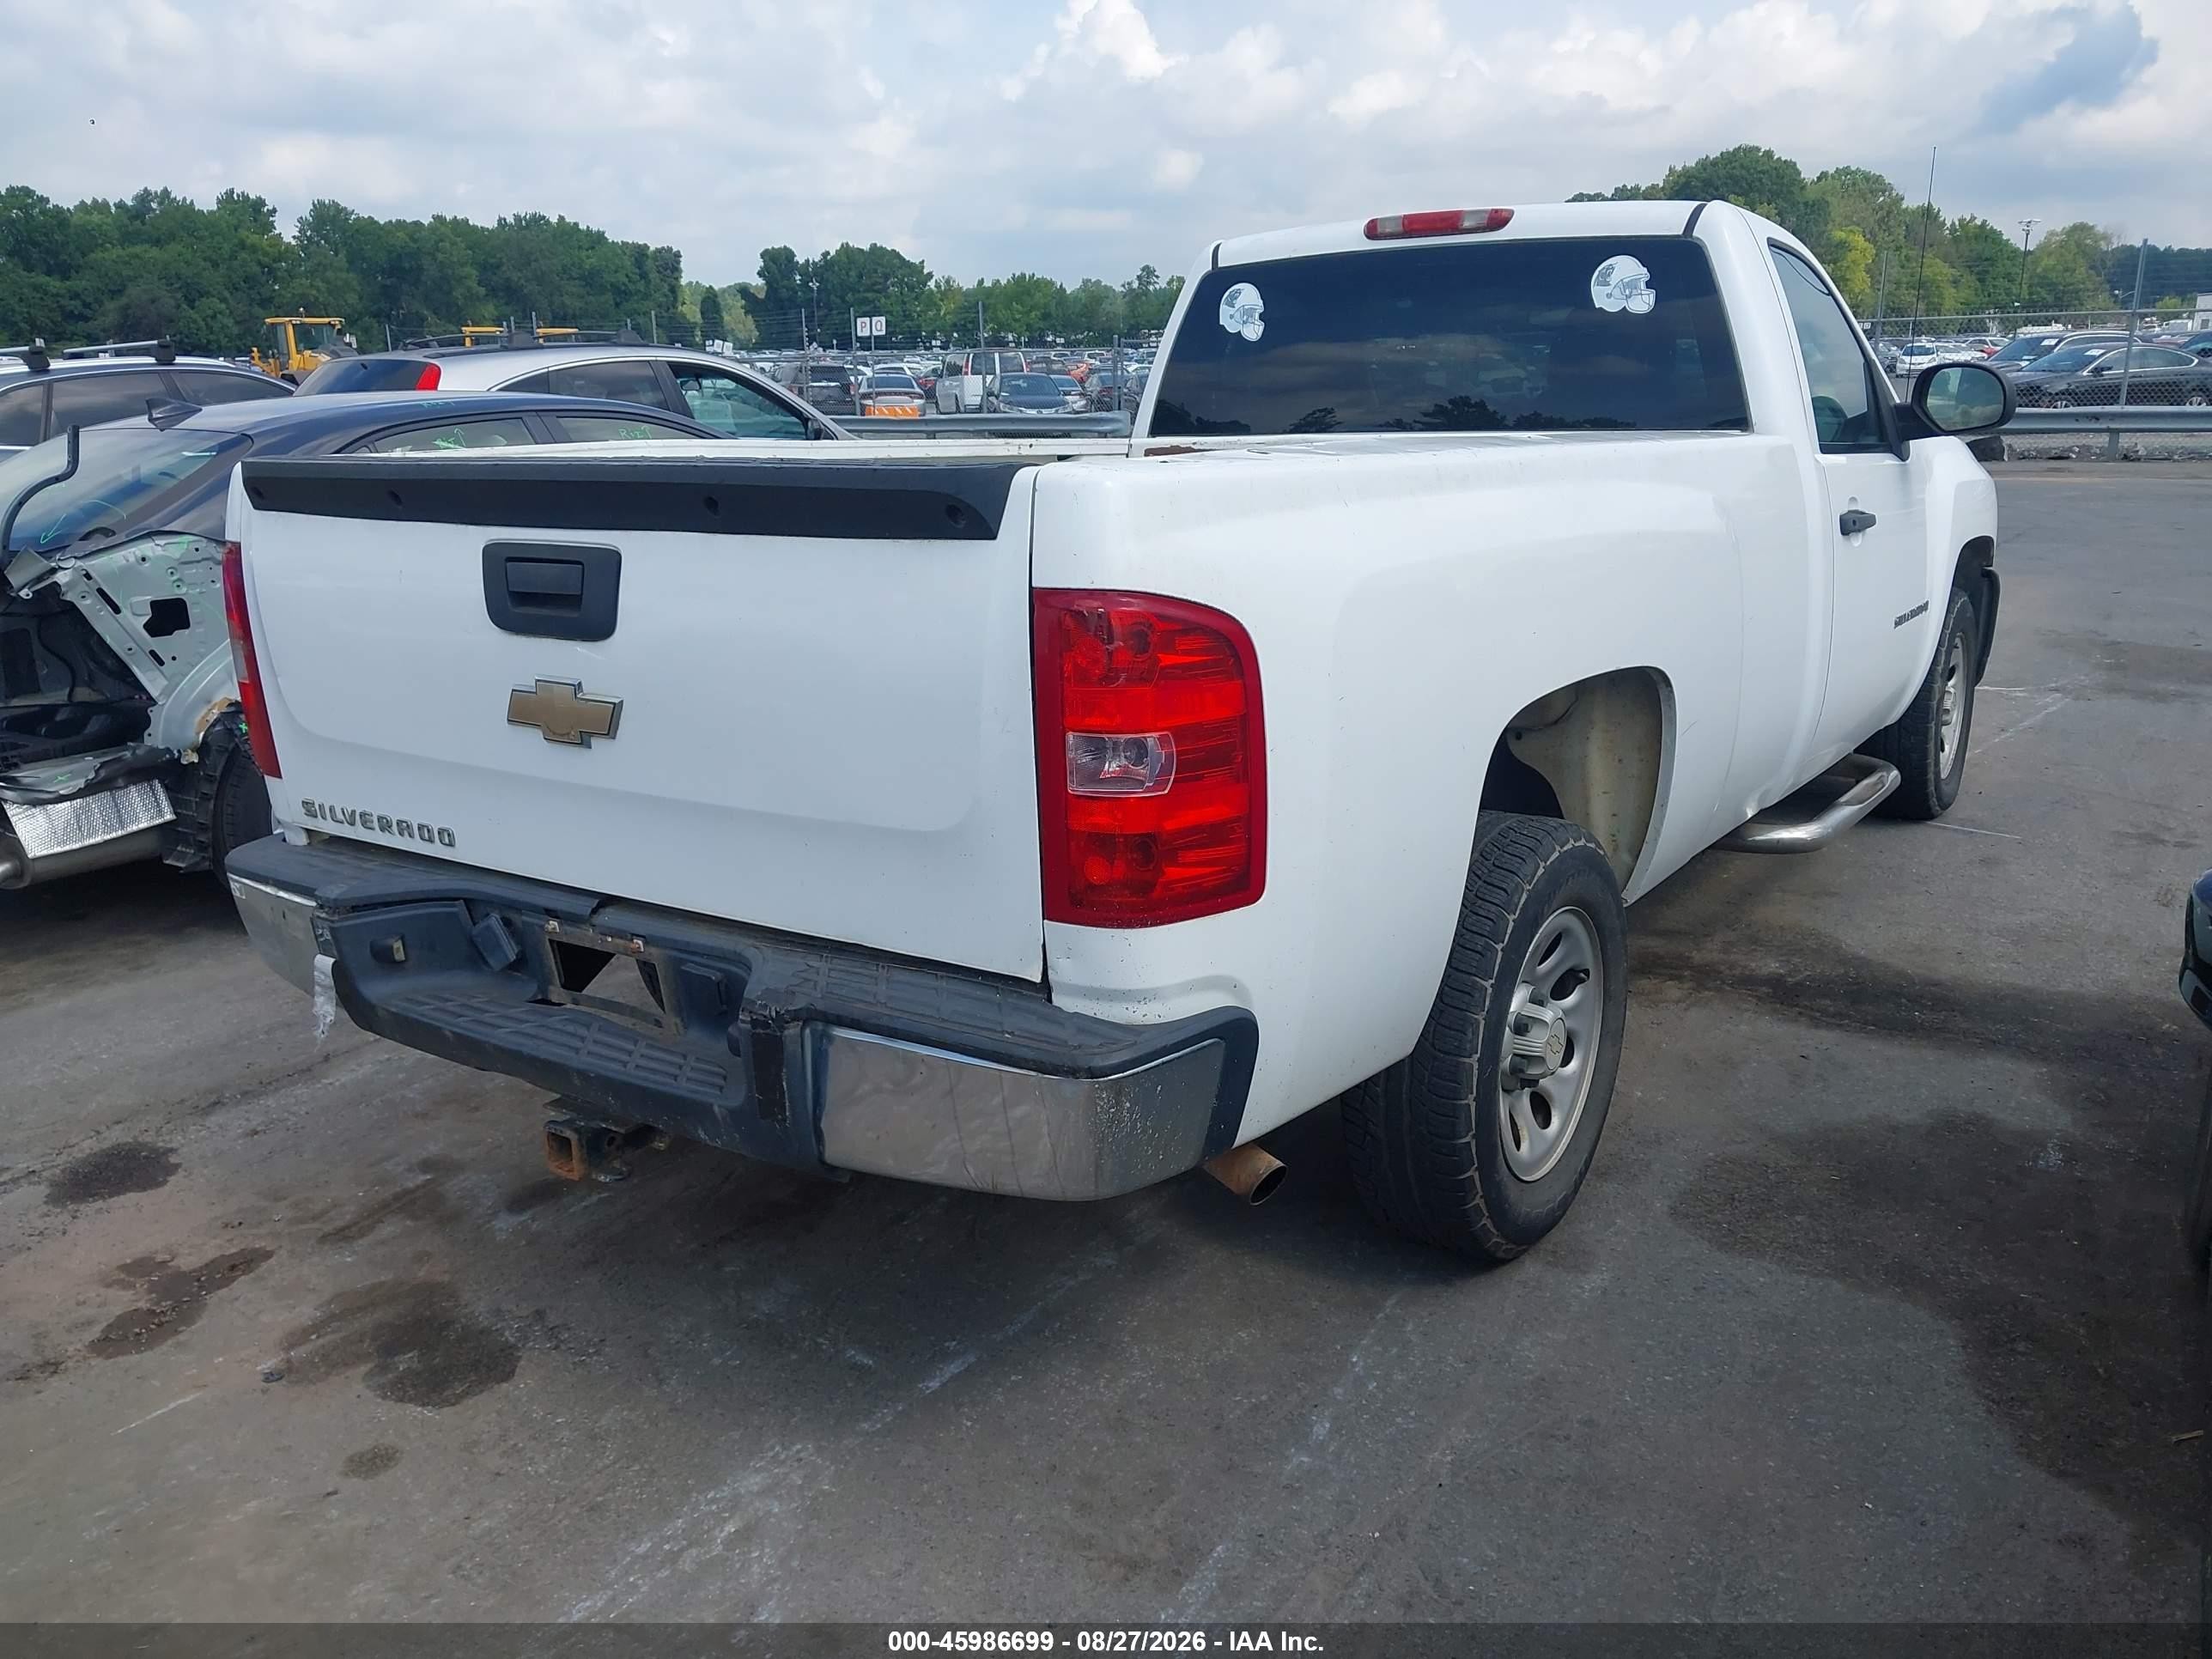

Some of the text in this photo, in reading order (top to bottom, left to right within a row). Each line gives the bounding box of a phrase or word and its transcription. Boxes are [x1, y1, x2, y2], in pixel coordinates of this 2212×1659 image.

[860, 321, 867, 333] P
[874, 319, 884, 332] Q
[301, 798, 457, 848] SILVERADO
